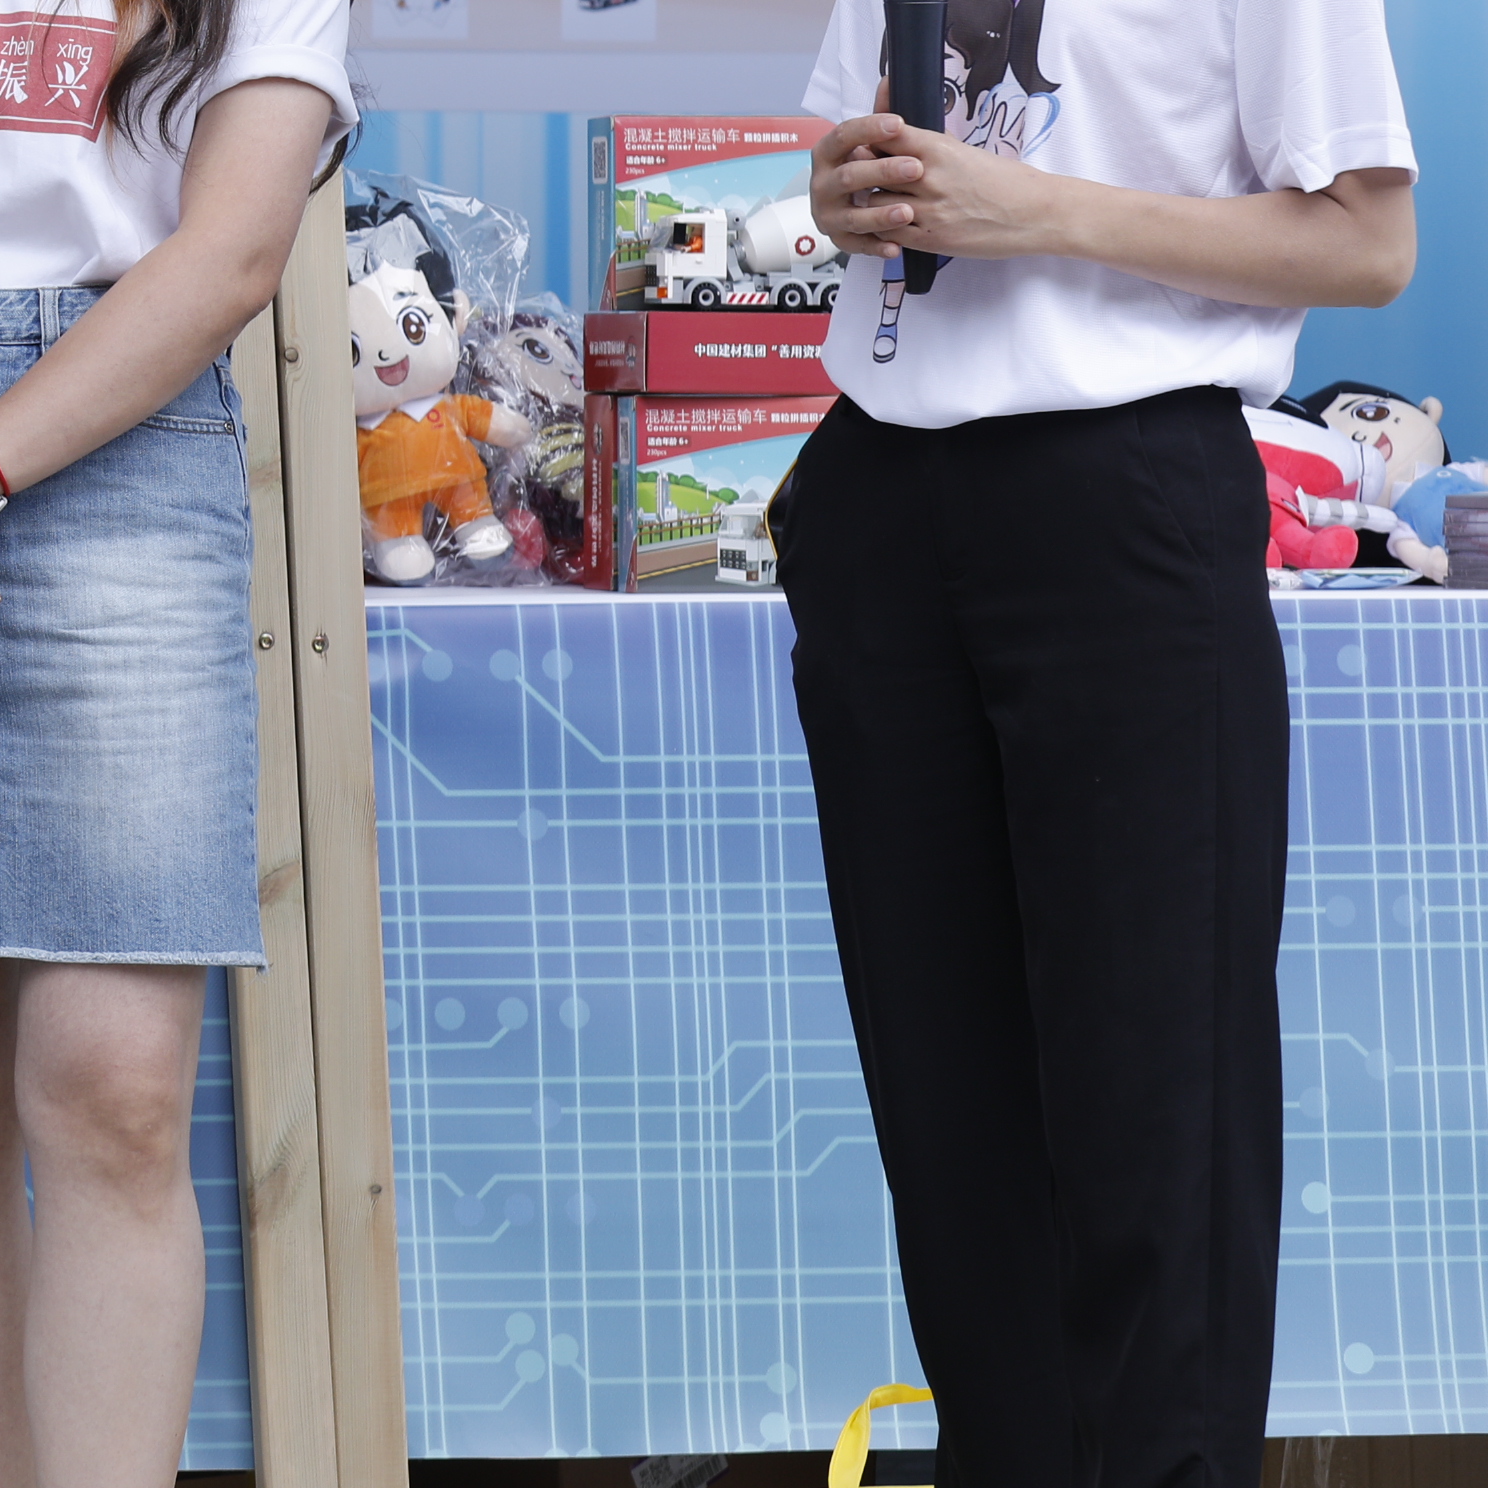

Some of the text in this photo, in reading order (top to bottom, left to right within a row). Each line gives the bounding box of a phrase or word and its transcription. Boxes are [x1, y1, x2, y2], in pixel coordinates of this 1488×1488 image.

[0, 35, 35, 57] zhèn
[56, 38, 94, 66] xīng
[623, 127, 740, 144] 混凝土搅拌运输车
[625, 142, 717, 152] Concrete mixer truck
[694, 342, 767, 359] 中国建材集团
[645, 408, 767, 425] 混凝土搅拌运输车
[646, 423, 743, 432] Concrete mixer truck
